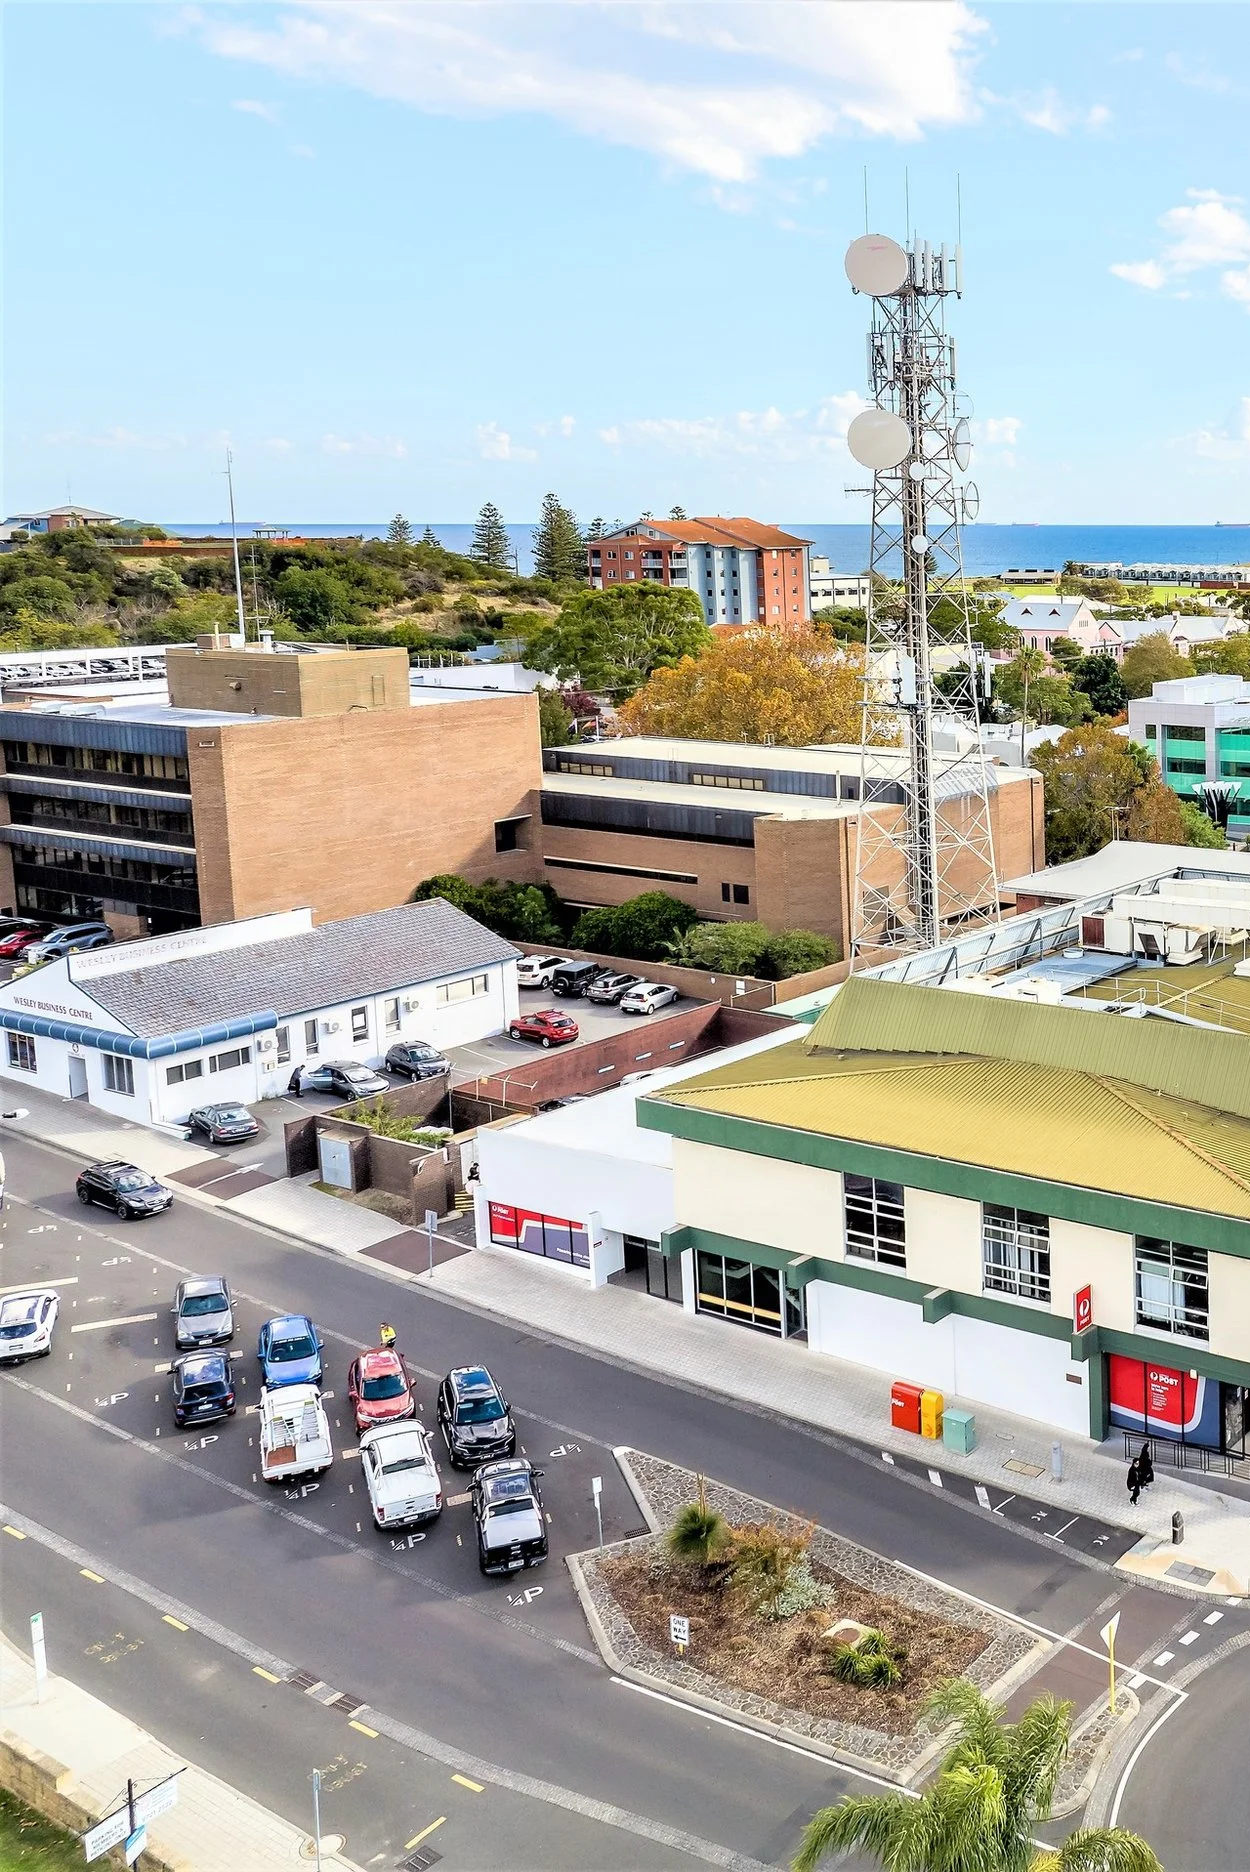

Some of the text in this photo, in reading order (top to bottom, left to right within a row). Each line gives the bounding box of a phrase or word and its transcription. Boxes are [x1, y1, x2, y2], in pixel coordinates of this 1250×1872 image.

[76, 954, 118, 969] WESLEY
[13, 996, 93, 1021] WESLEY BUSINESS CENTRE
[1079, 1315, 1090, 1327] POST
[1158, 1375, 1179, 1386] POST
[672, 1618, 685, 1628] ONE
[673, 1626, 686, 1634] WAY
